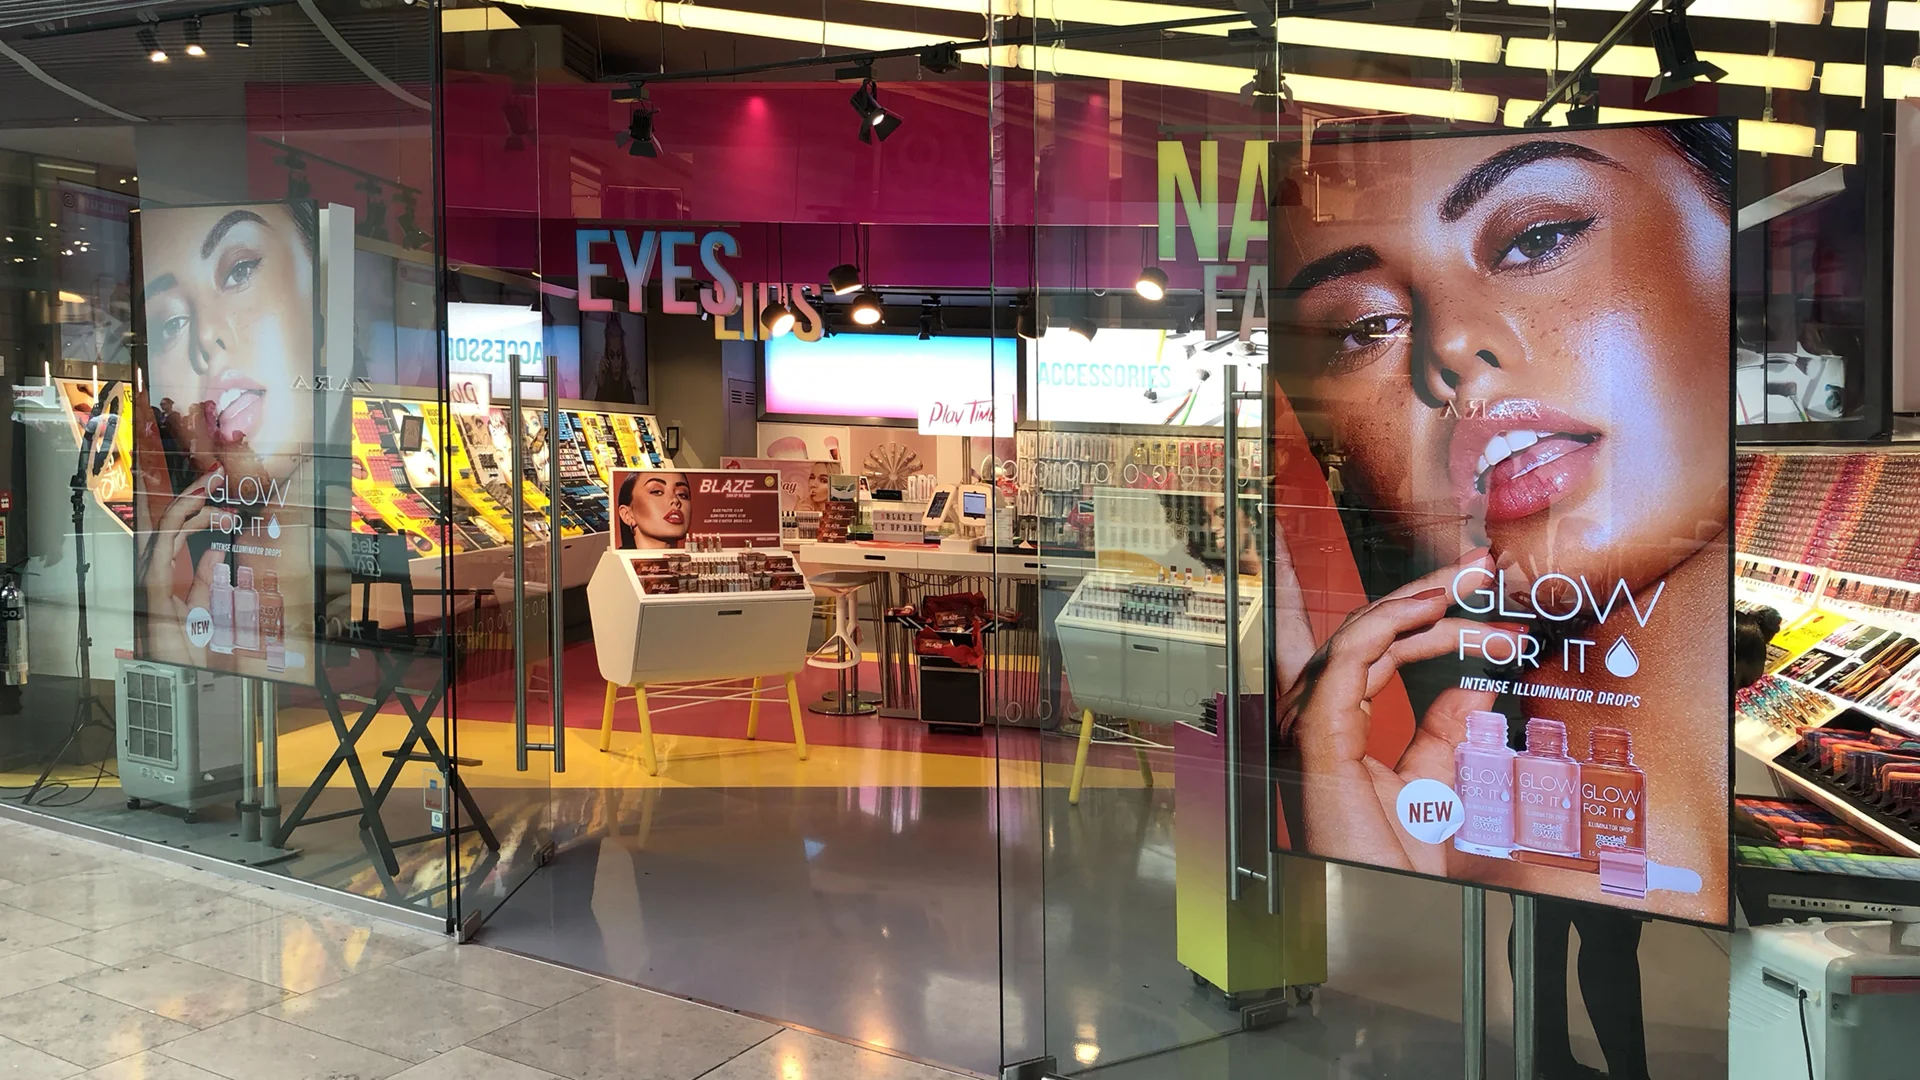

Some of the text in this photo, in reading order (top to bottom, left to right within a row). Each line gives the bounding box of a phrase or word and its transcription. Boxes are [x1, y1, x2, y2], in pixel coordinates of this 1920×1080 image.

[576, 229, 742, 316] EYES
[1036, 360, 1173, 389] ACCESSORIES
[928, 401, 964, 428] Play
[207, 473, 291, 509] GLOW
[699, 479, 754, 493] BLAZE
[781, 481, 798, 494] ay
[210, 512, 264, 537] FOR IT
[875, 523, 885, 531] IT
[211, 542, 282, 557] INTENSE ILLUMINATOR DROPS
[1453, 567, 1666, 628] GLOW
[191, 621, 210, 636] NEW
[1458, 628, 1597, 674] FOR IT
[1460, 676, 1641, 708] INTENSE ILLUMINATOR DROPS
[1460, 766, 1513, 787] GLOW
[1519, 771, 1576, 794] GLOW
[1461, 784, 1499, 799] FOR IT
[1520, 791, 1560, 808] FOR IT
[1581, 783, 1642, 806] GLOW
[1408, 800, 1454, 823] NEW
[1583, 802, 1624, 819] FOR IT
